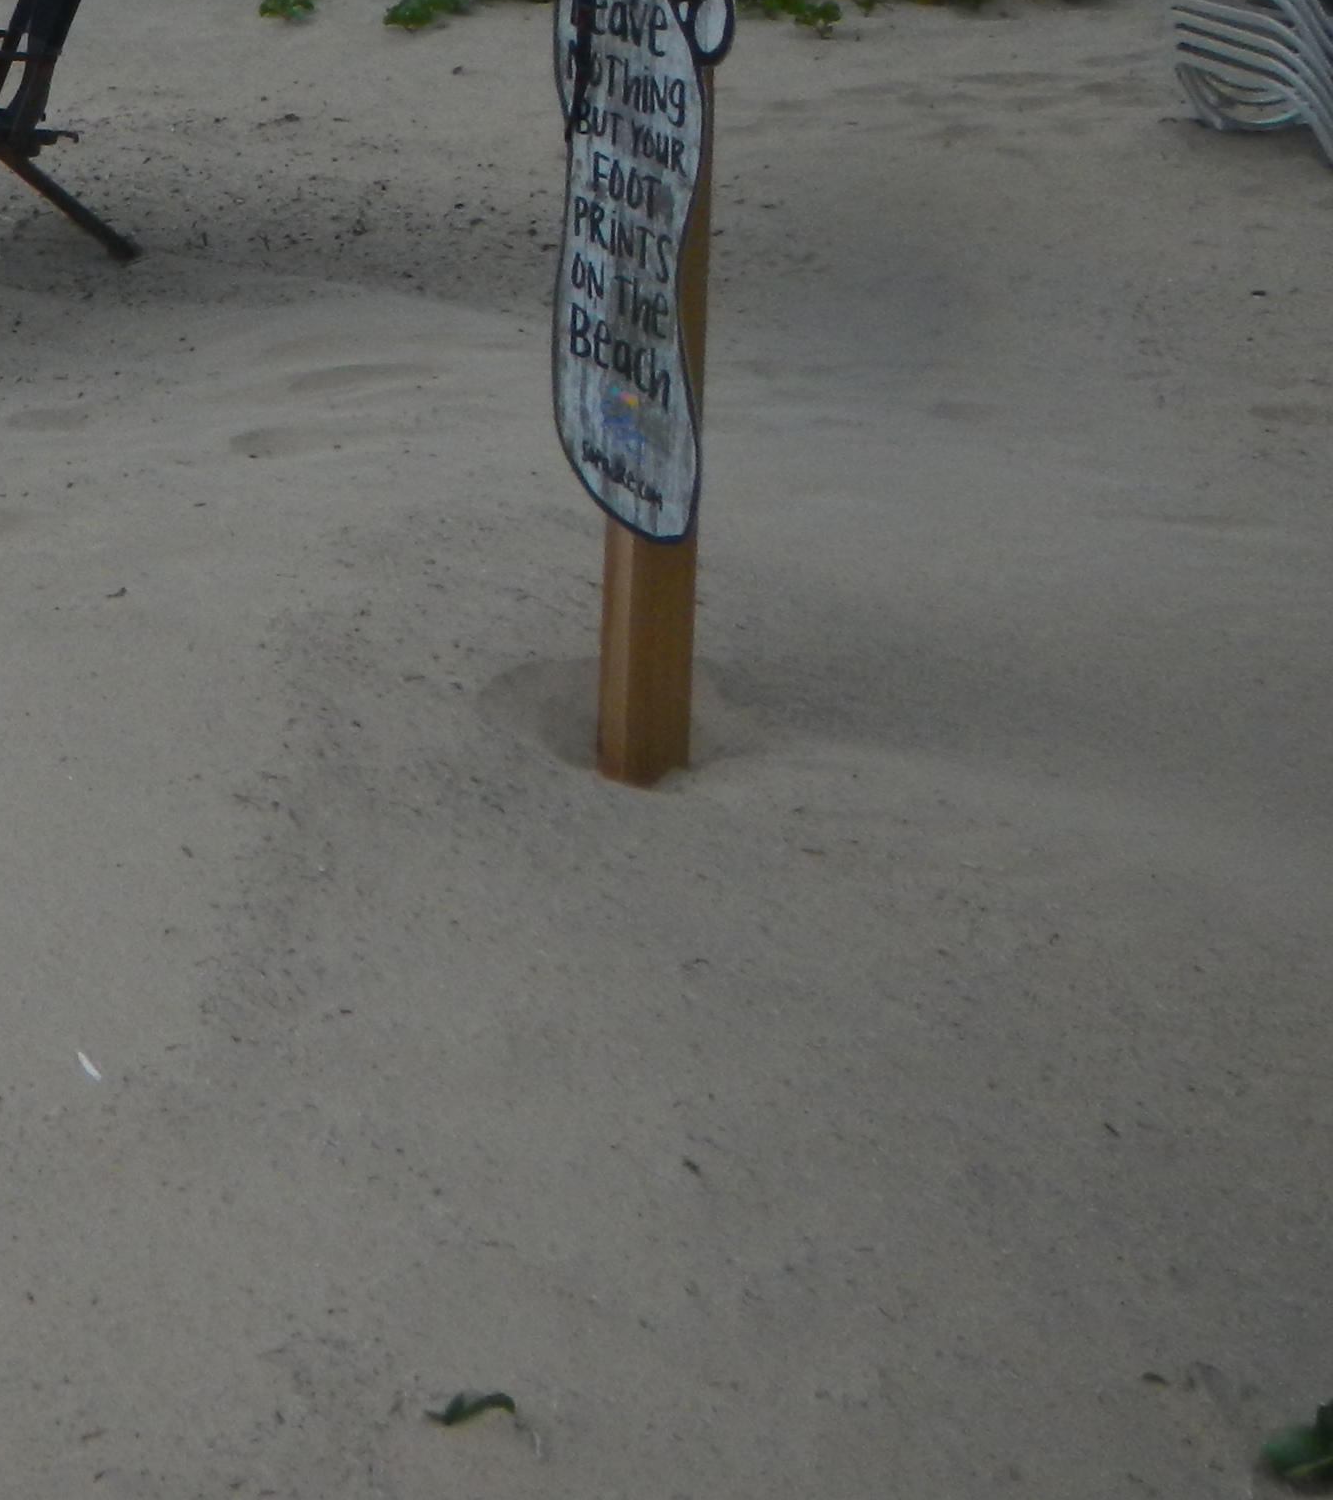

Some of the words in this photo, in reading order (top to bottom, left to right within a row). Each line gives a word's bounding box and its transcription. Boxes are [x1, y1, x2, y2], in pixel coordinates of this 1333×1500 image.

[576, 98, 624, 146] BUT
[632, 118, 687, 177] YOUR
[593, 151, 662, 219] FOOT
[571, 251, 605, 300] ON
